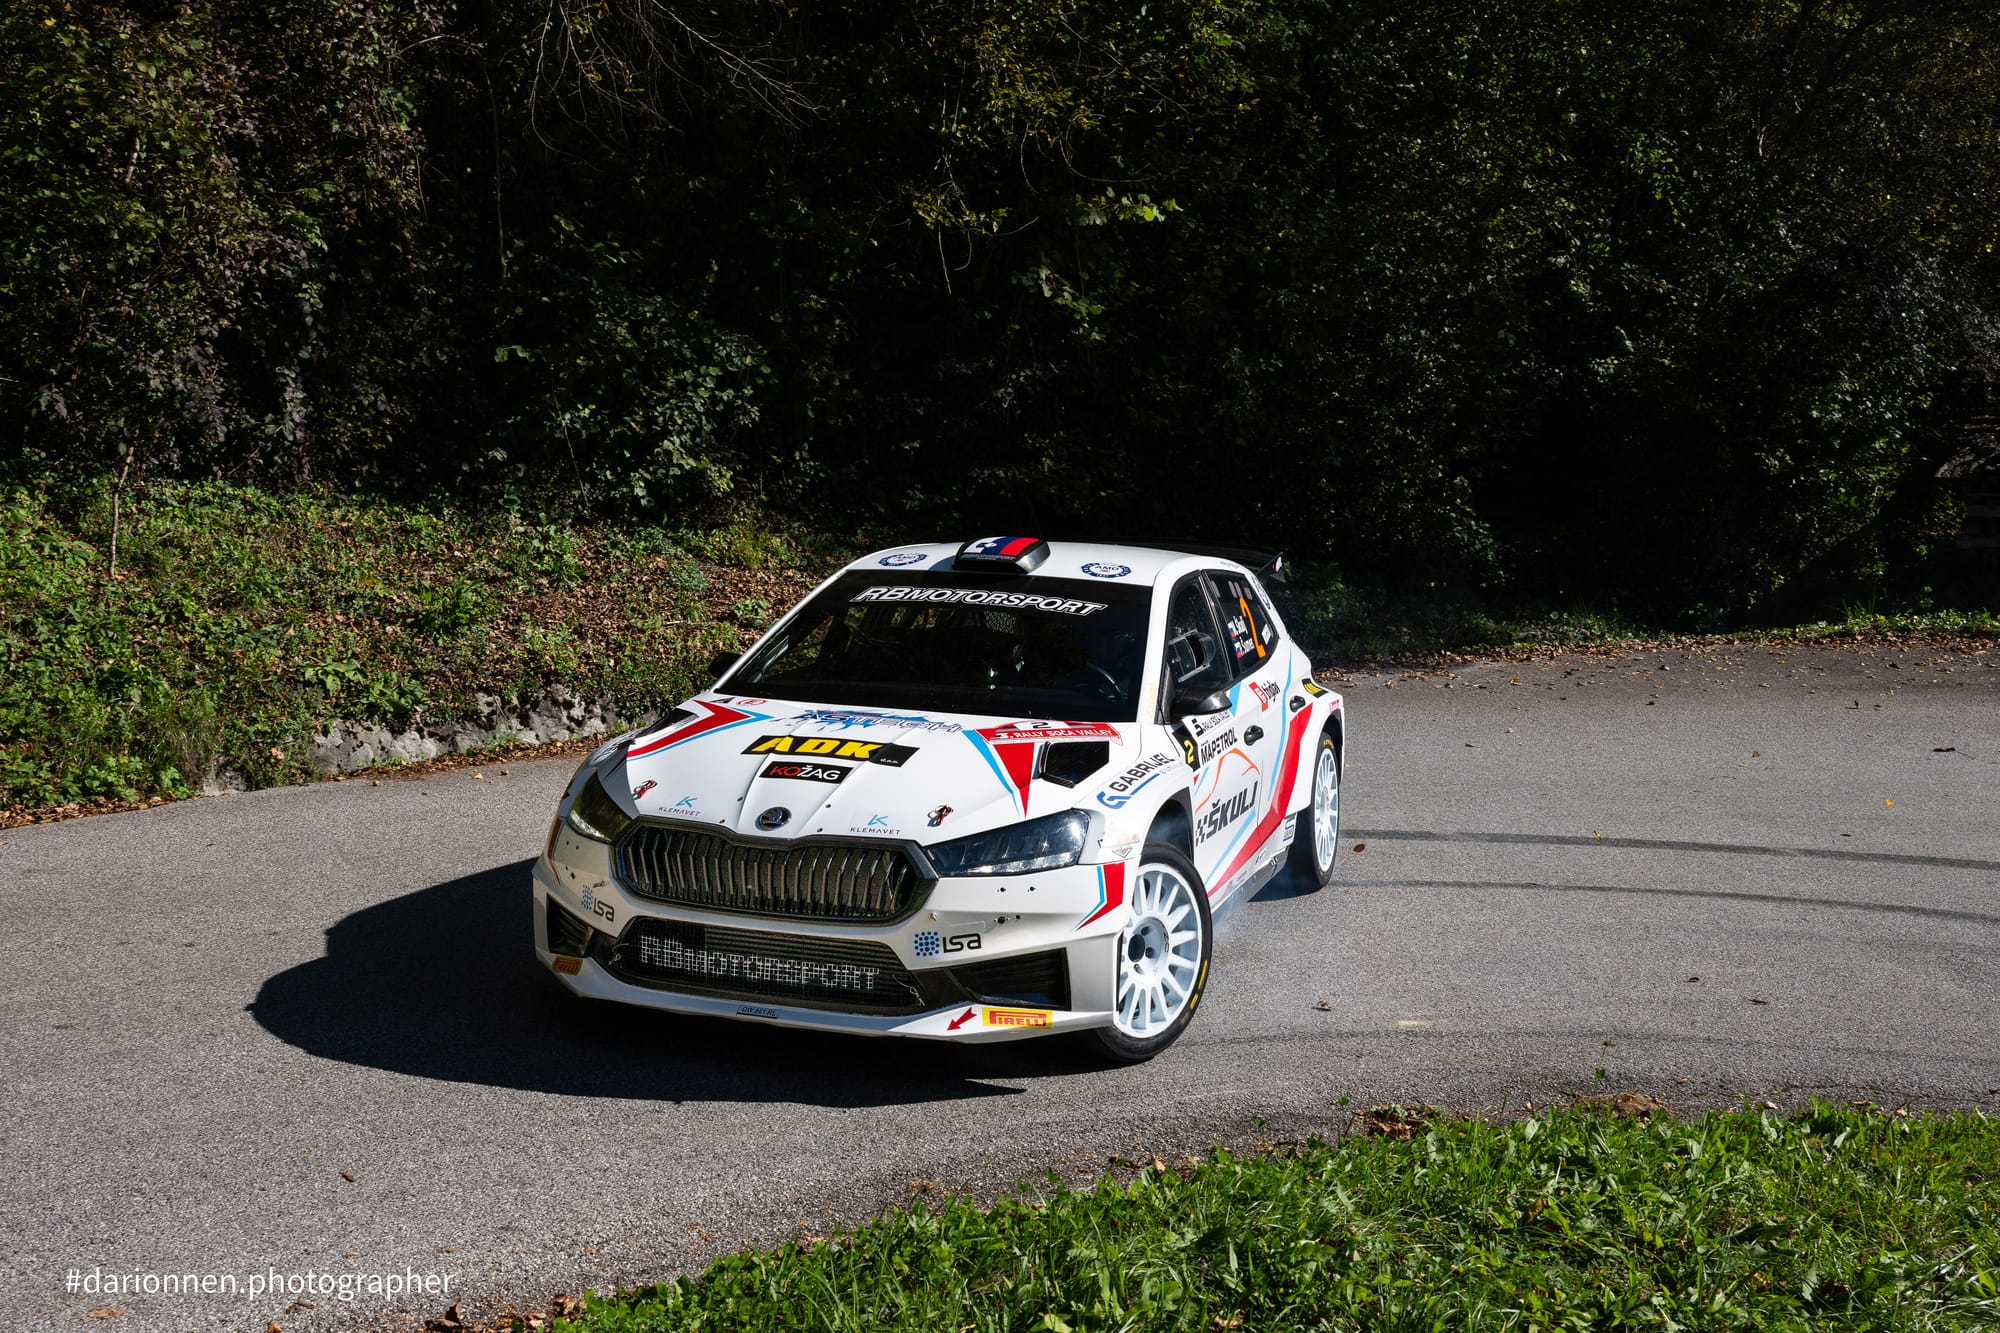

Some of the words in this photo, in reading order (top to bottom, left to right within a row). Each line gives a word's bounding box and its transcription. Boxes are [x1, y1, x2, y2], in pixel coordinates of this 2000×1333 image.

[850, 586, 1108, 616] RBMOTORSPORT
[1013, 731, 1044, 739] RALLY
[1075, 729, 1113, 737] VALLEY
[752, 736, 883, 758] ADK
[1184, 740, 1194, 764] 2
[1201, 728, 1237, 765] MAPETROL
[770, 764, 841, 780] KOŽAG
[1108, 753, 1175, 792] GABRIJEL
[658, 806, 702, 817] KLEMAVET
[1206, 781, 1258, 839] ŠKULJ
[850, 827, 902, 835] KLEMAVET
[989, 1010, 1047, 1027] PIRELLI
